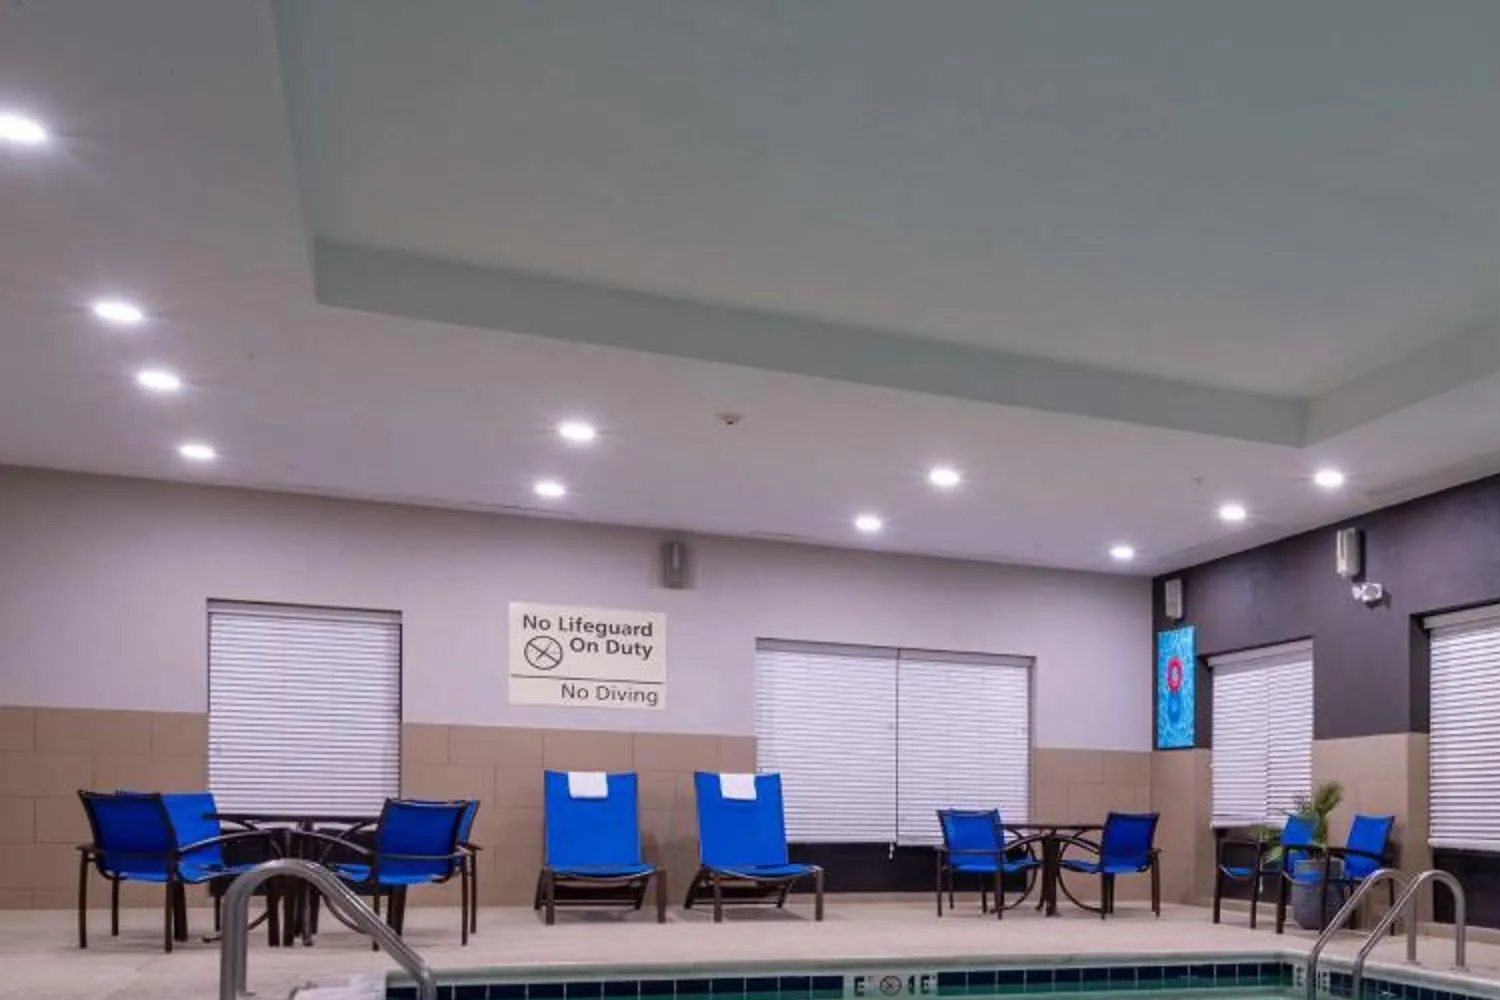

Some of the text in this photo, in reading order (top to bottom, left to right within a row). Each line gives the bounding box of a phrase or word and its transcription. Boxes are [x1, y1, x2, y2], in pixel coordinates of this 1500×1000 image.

[523, 614, 653, 638] No Lifeguard
[569, 637, 653, 660] On Duty
[561, 683, 658, 707] No Diving
